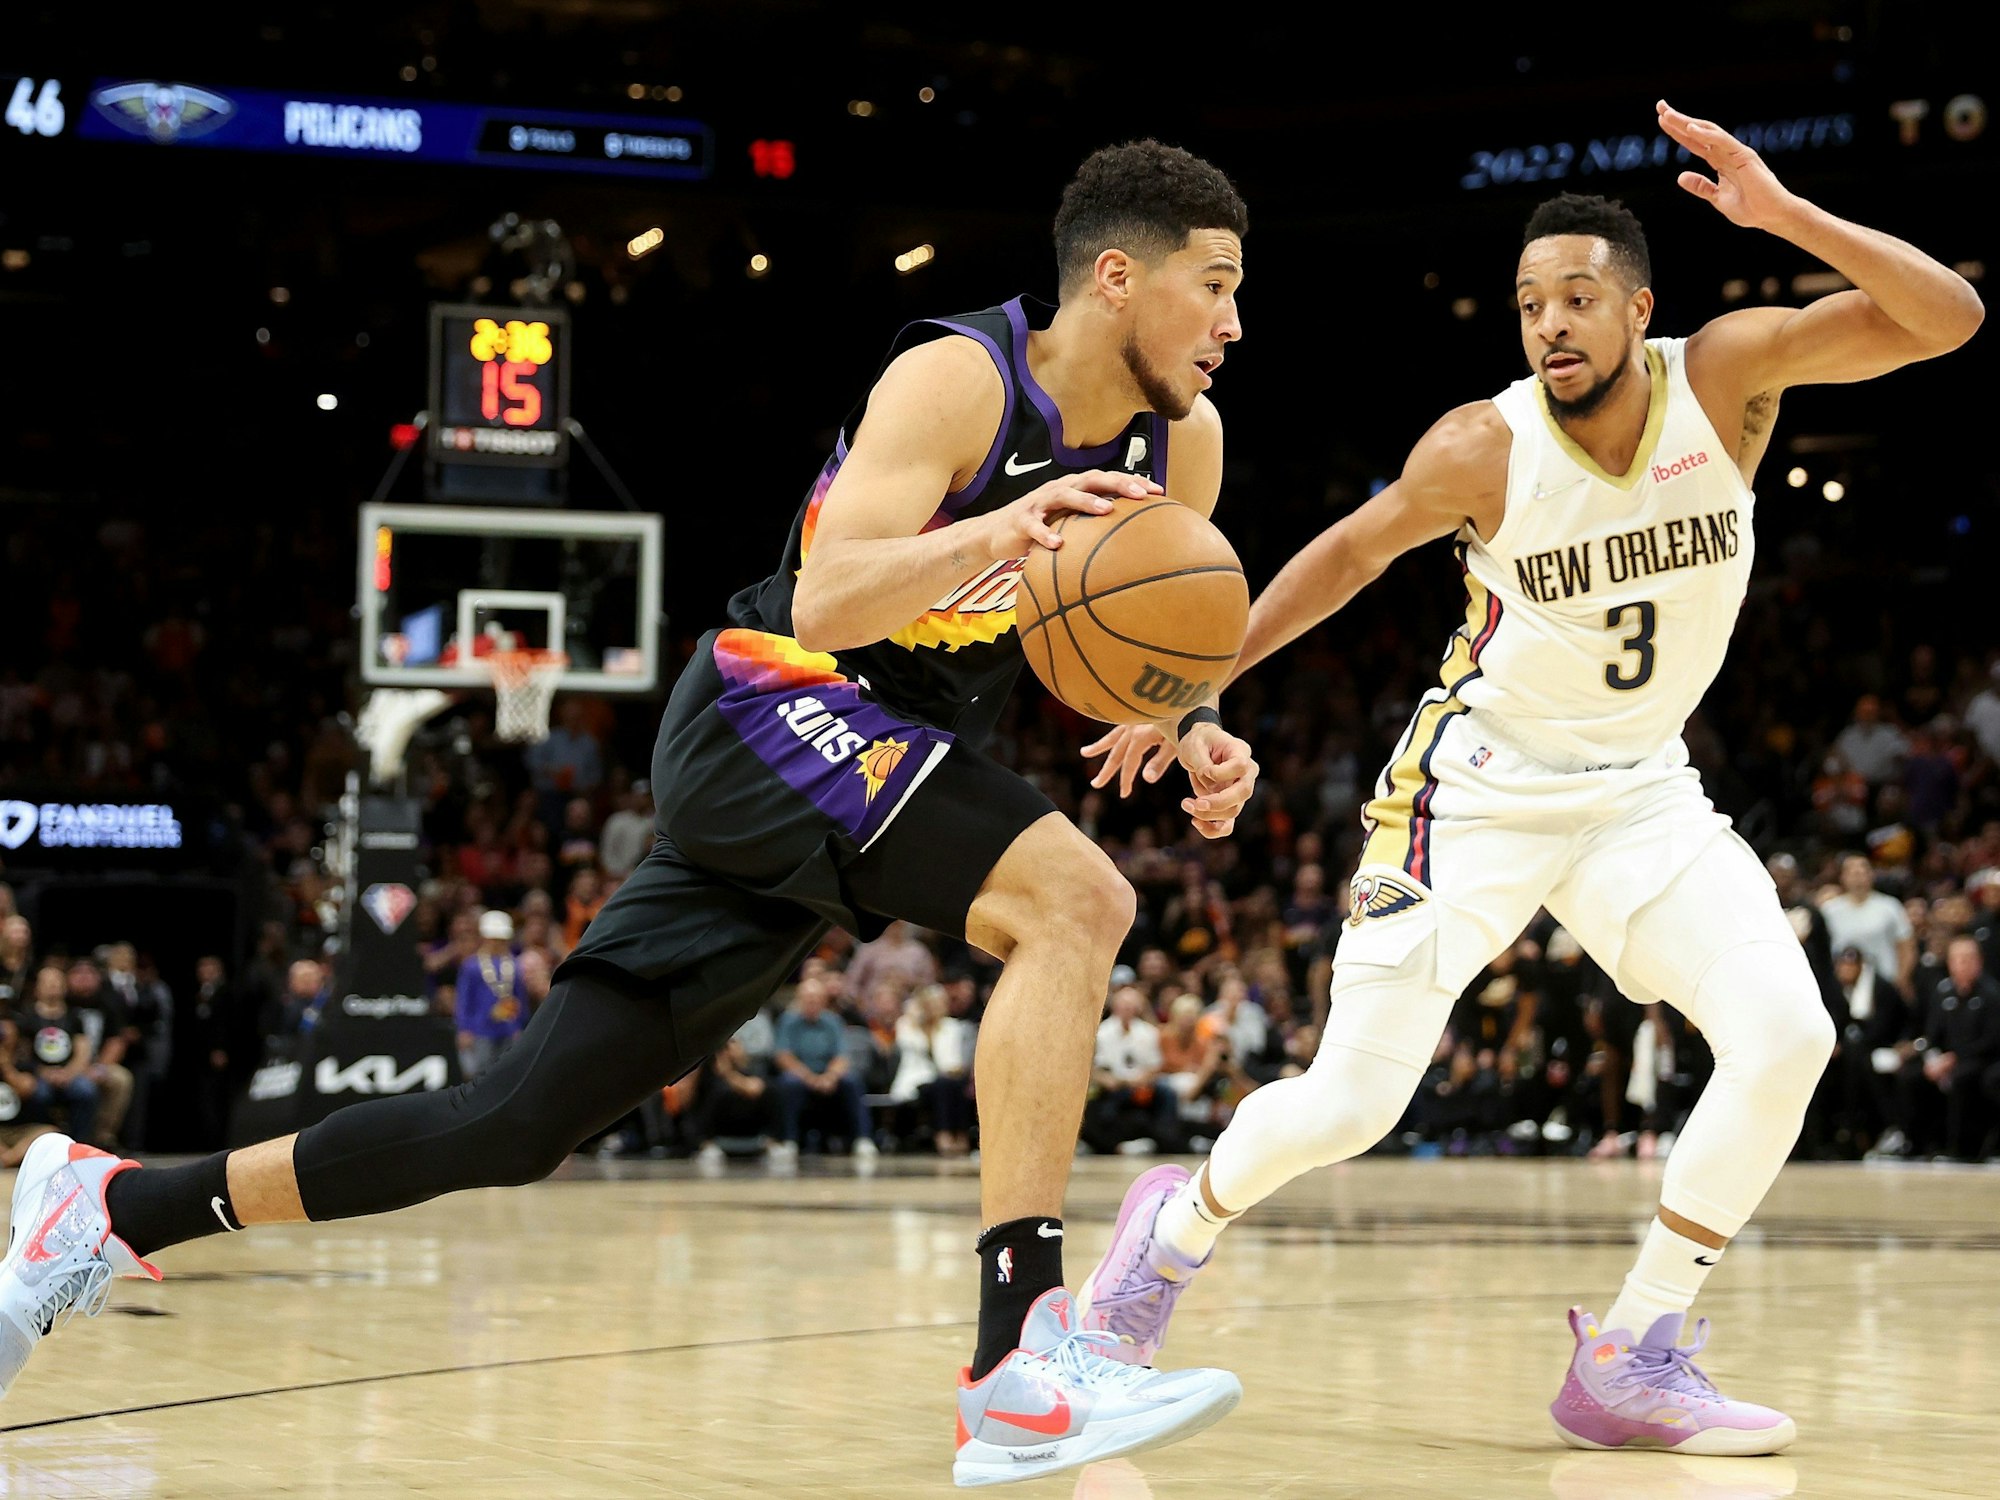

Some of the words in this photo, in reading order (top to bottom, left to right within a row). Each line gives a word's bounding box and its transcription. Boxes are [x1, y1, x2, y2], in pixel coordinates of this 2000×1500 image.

[5, 77, 65, 137] 46
[285, 101, 422, 151] PELICANS
[1461, 141, 1575, 190] 2022
[481, 360, 541, 426] 15
[1651, 451, 1708, 484] ibotta
[1514, 542, 1591, 603] NEW
[1605, 509, 1738, 583] ORLEANS
[1603, 599, 1657, 691] 3
[1131, 662, 1211, 709] Wil
